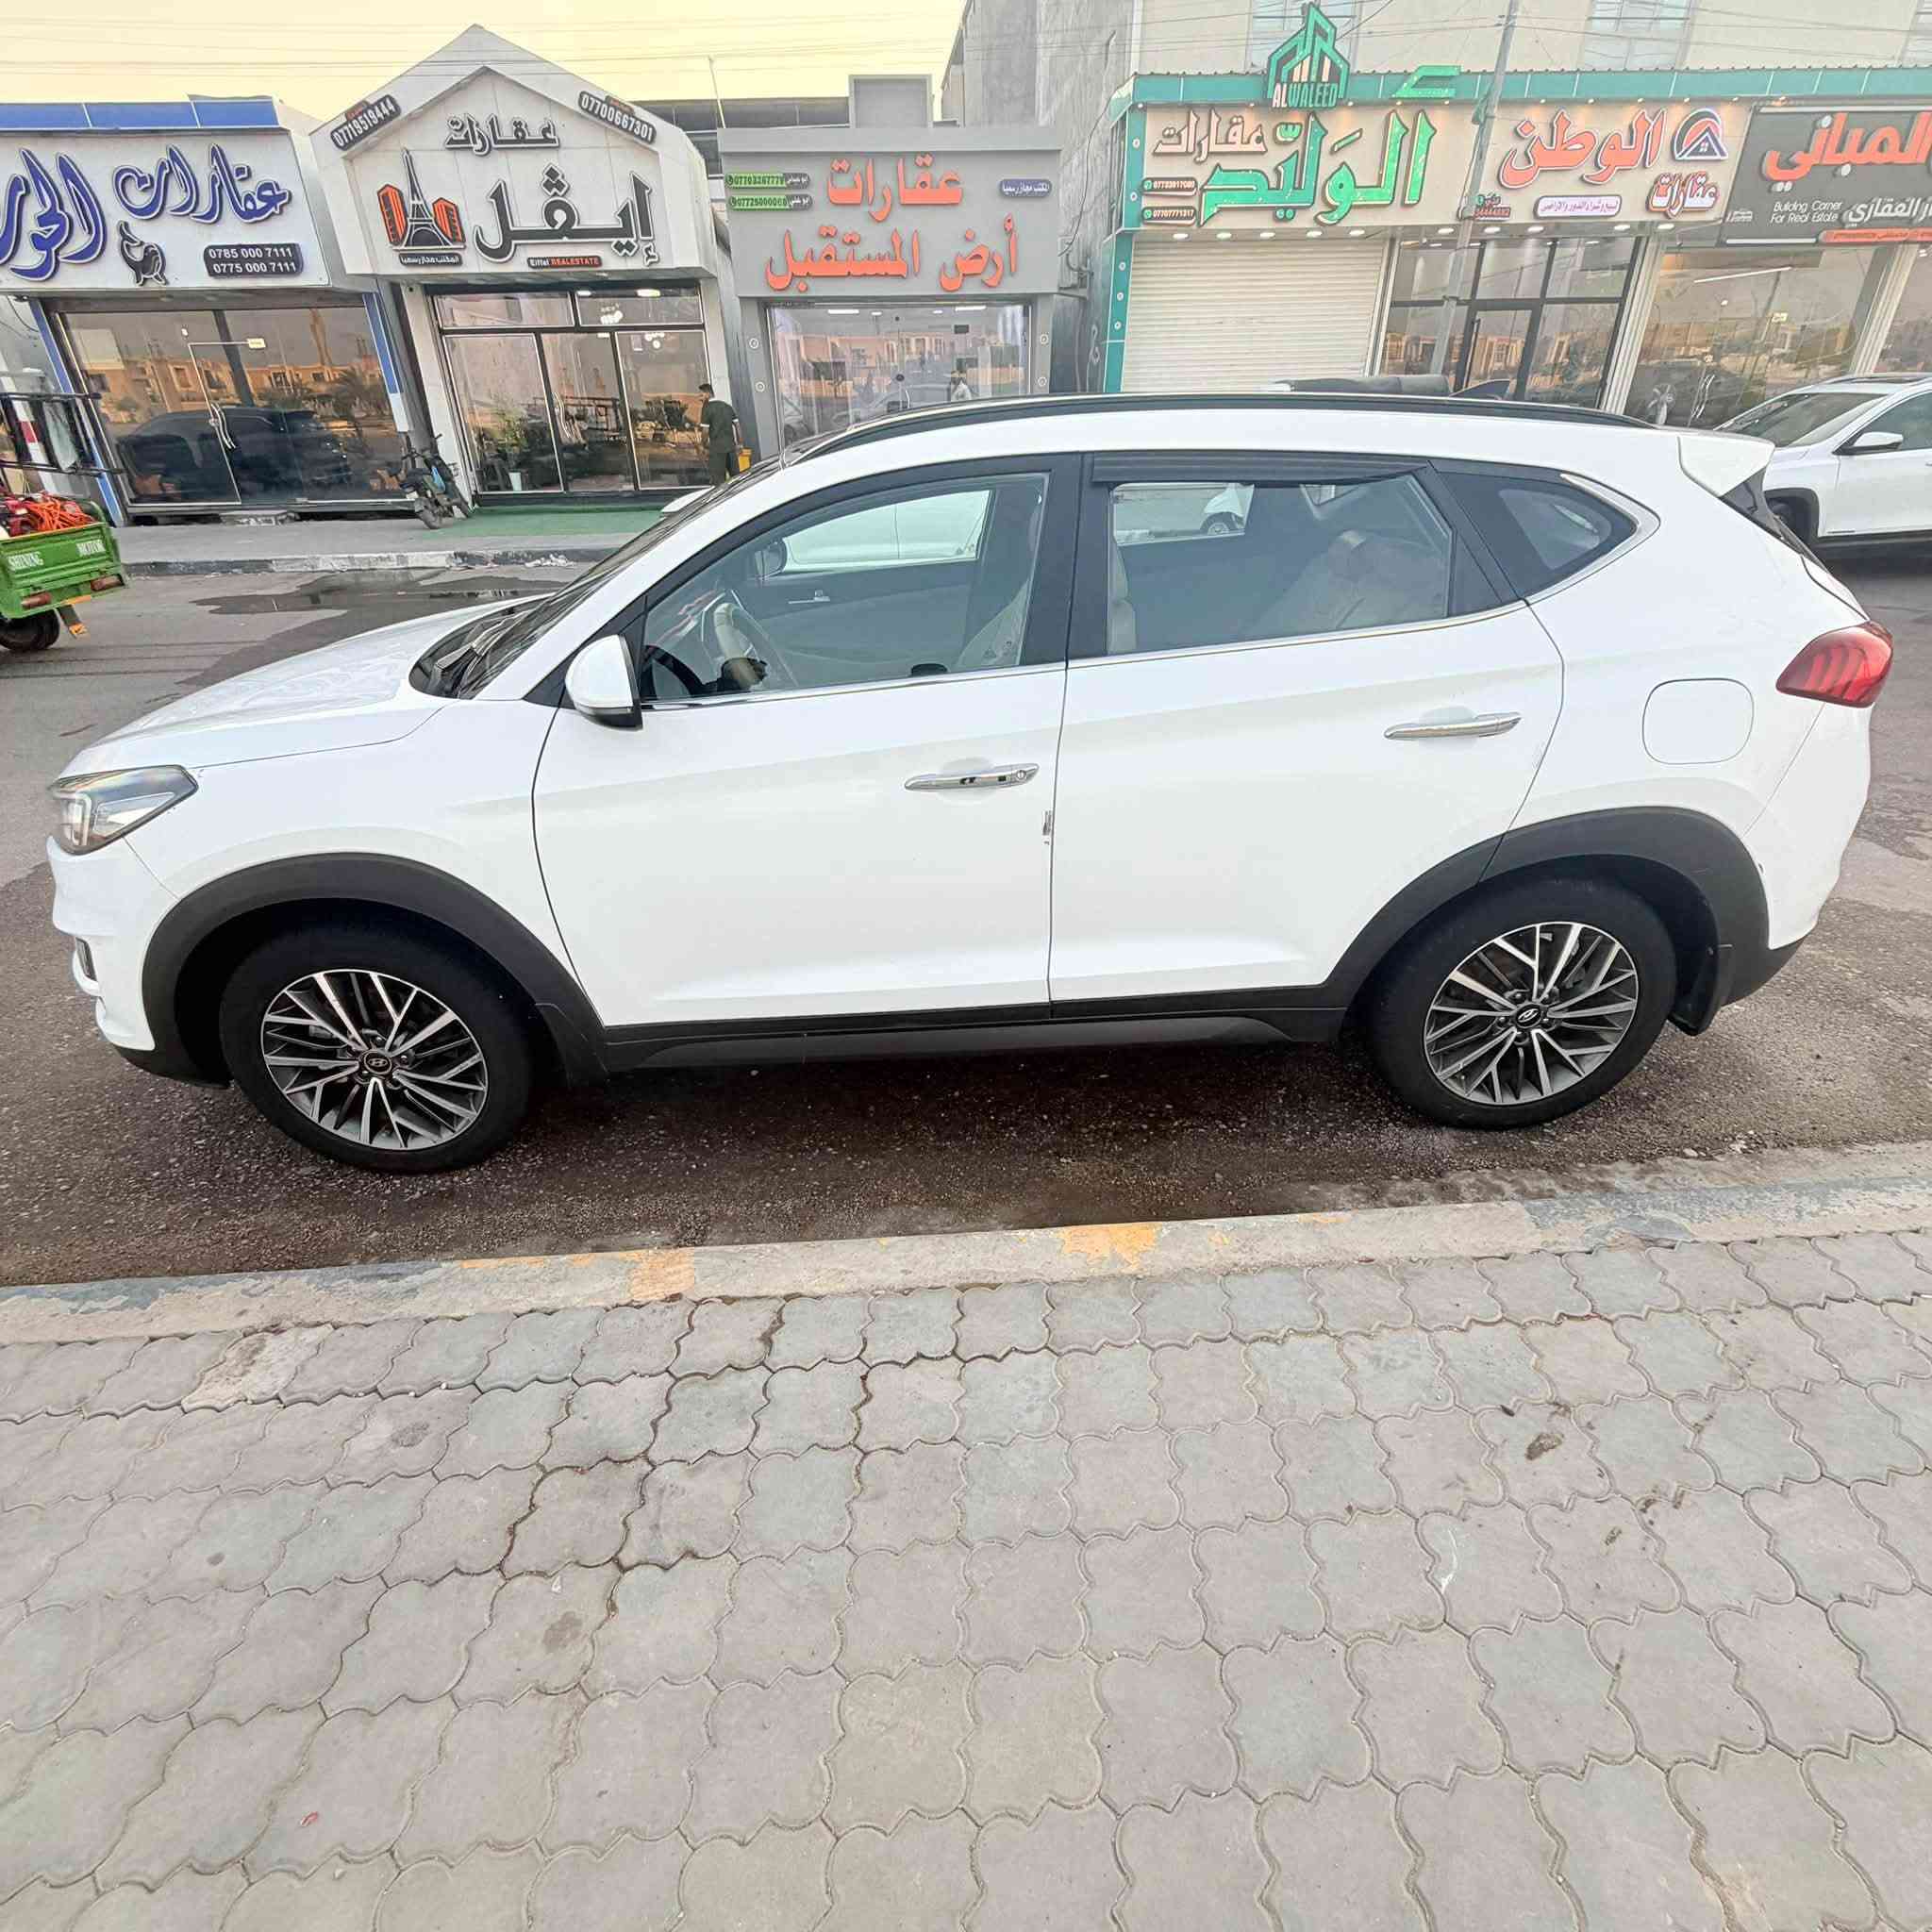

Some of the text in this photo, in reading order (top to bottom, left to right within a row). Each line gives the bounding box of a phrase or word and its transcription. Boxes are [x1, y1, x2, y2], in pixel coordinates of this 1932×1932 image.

[332, 97, 396, 147] 07719519444
[444, 112, 560, 157] عقارات
[580, 93, 654, 142] 07700667301
[1152, 108, 1269, 164] عقارات
[1498, 108, 1667, 190] الوطن
[113, 142, 292, 225] عقارات
[826, 153, 964, 223] عقارات
[1648, 171, 1720, 219] عقارات
[1845, 196, 1922, 227] العقاري
[208, 247, 293, 260] 0785 000 7111
[212, 260, 297, 275] 0775 000 7111
[765, 212, 1018, 293] أرض المستقبل
